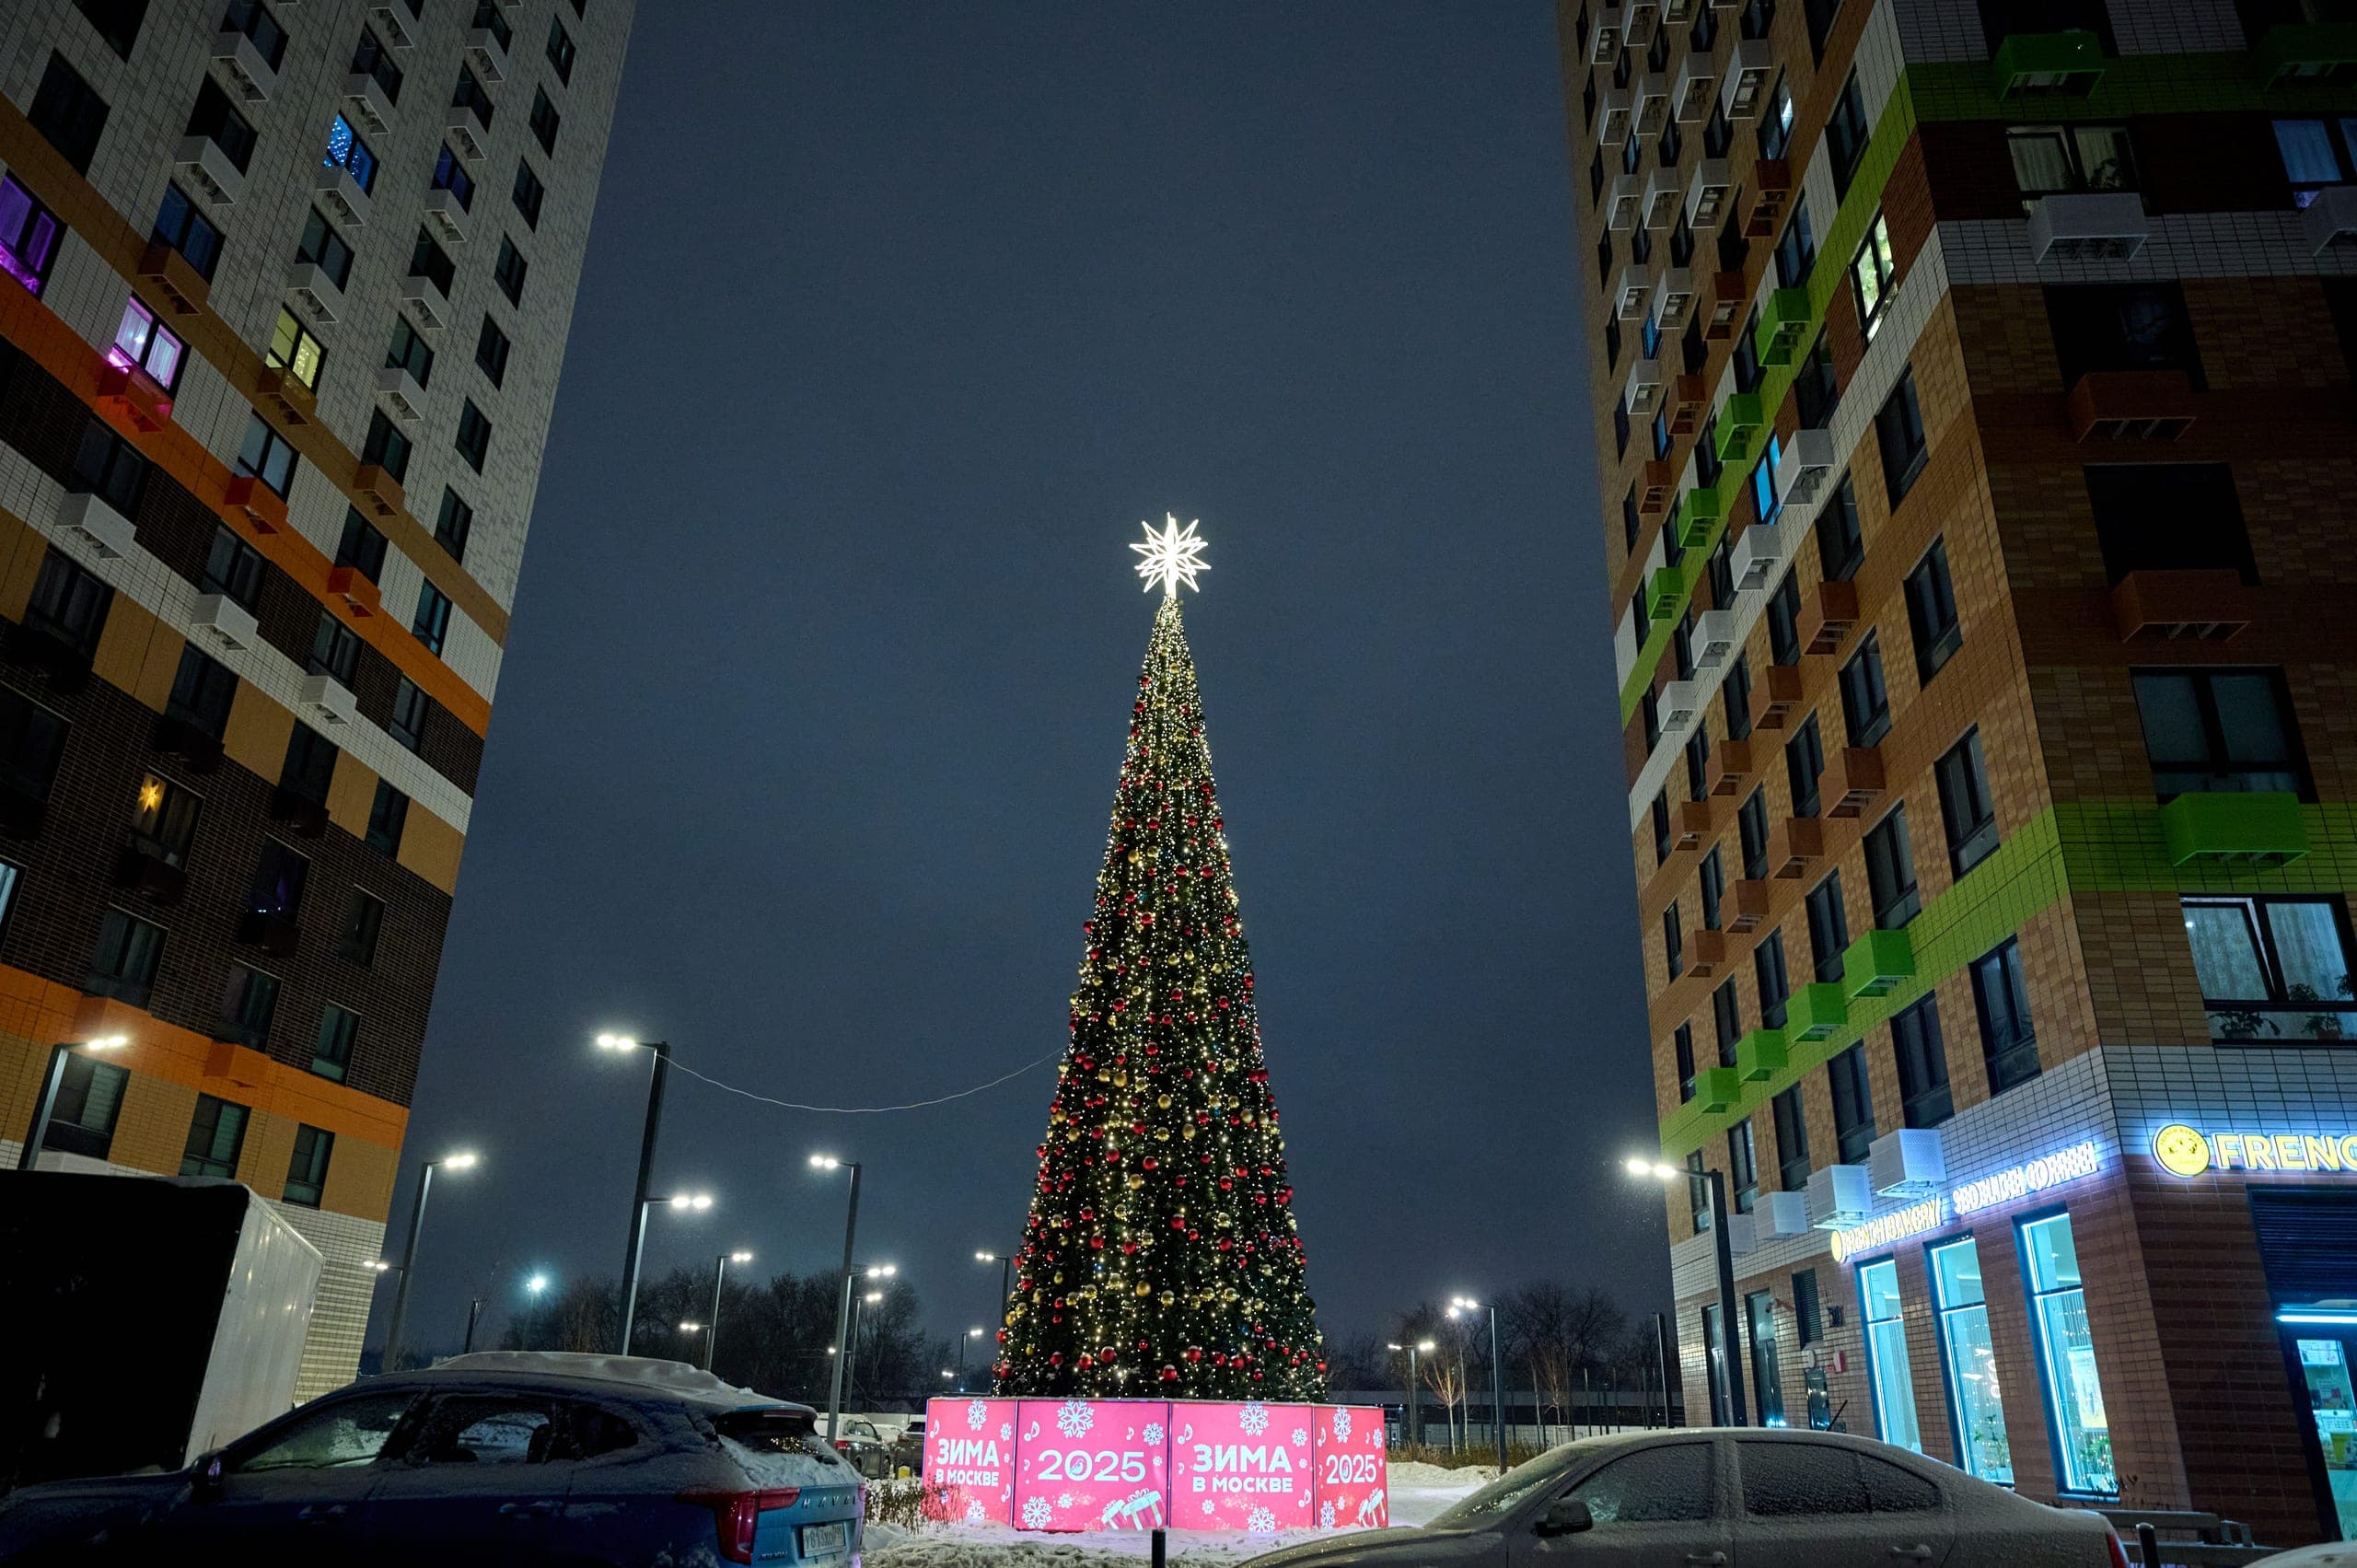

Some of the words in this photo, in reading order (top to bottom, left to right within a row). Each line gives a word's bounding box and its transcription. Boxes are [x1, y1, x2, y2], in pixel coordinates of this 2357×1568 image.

[936, 1438, 1000, 1468] ЗИМА
[1038, 1449, 1146, 1482] 2025
[1192, 1444, 1294, 1473] ЗИМА
[935, 1469, 945, 1483] В
[946, 1469, 1000, 1487] МОСКВЕ
[1326, 1454, 1376, 1484] 2025
[1192, 1477, 1206, 1493] В
[1212, 1476, 1294, 1493] МОСКВЕ
